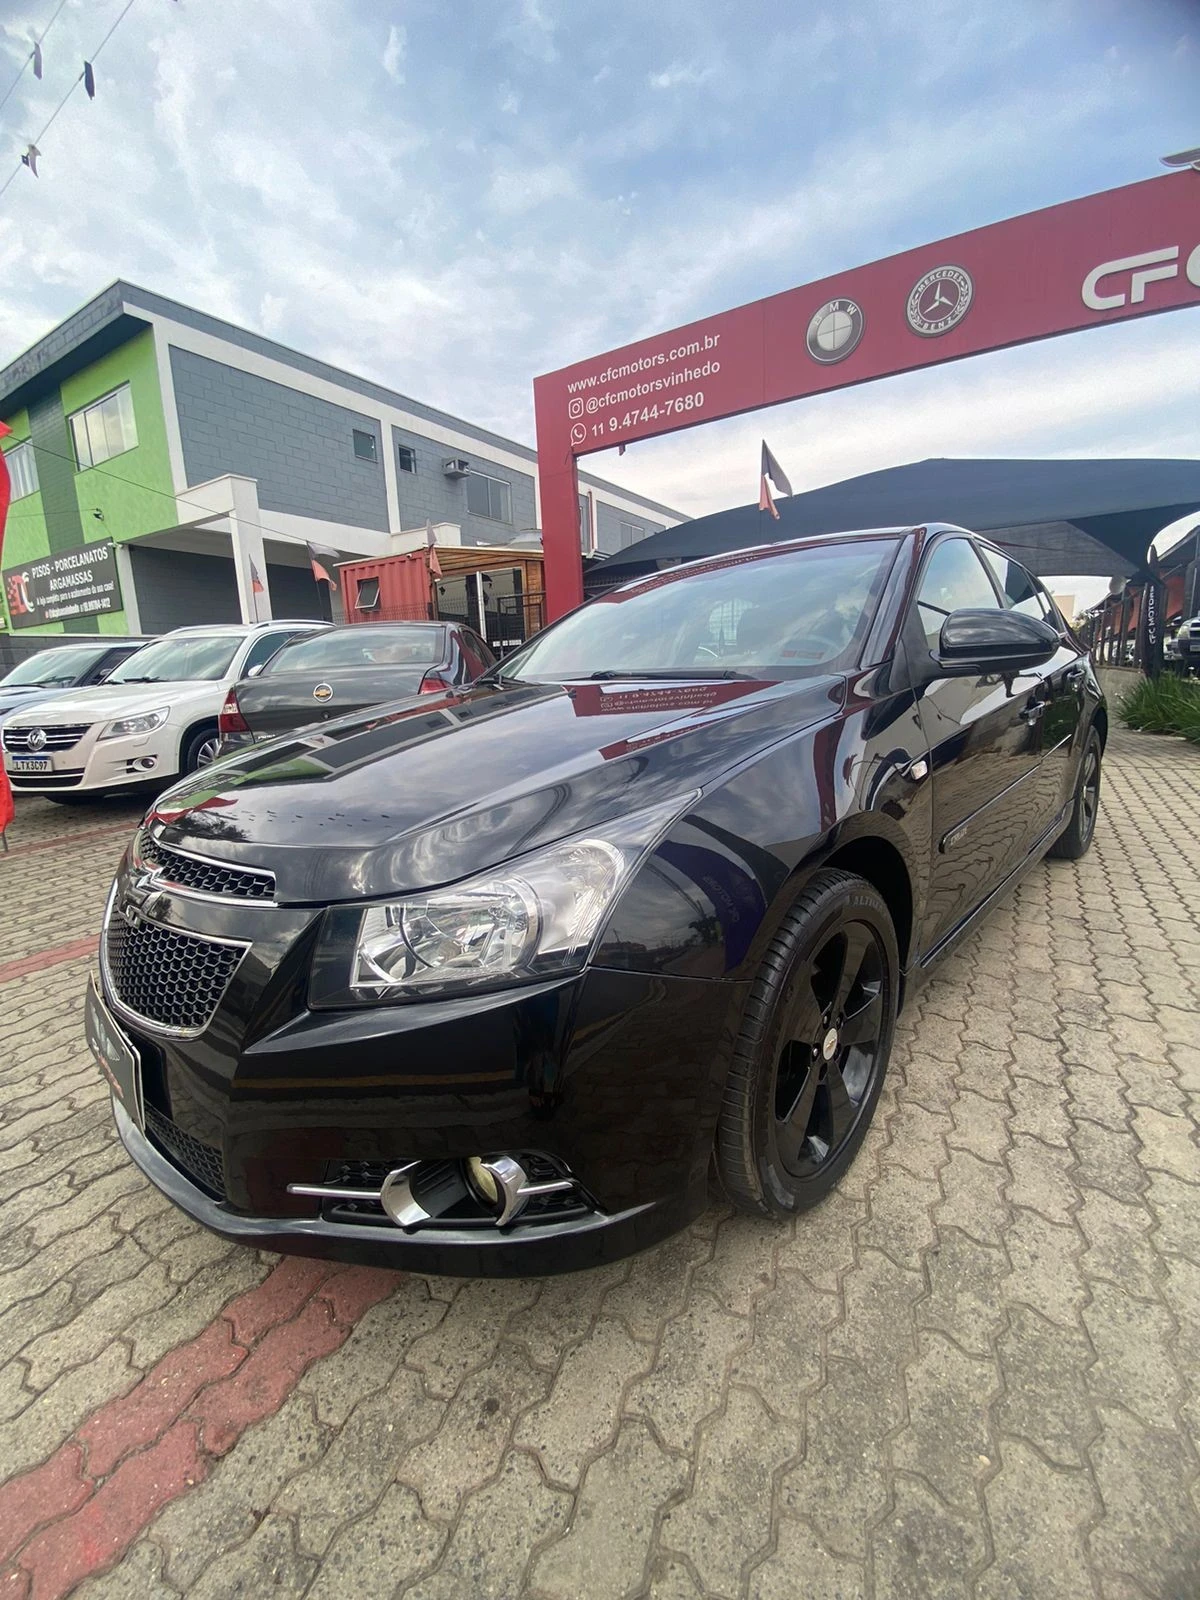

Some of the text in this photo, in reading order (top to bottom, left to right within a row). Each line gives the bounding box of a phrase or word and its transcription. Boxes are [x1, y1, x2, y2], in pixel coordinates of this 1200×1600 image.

[917, 269, 963, 293] MERCEDES
[922, 316, 955, 330] BENZ
[567, 333, 721, 394] www.cfcmotors.com.br
[586, 360, 721, 414] @cfcmotorsvinhedo
[591, 391, 704, 437] 11 9.4744-7680
[32, 564, 50, 578] PISOS
[54, 546, 108, 572] PORCELANATOS
[50, 570, 93, 591] ARGAMASSAS
